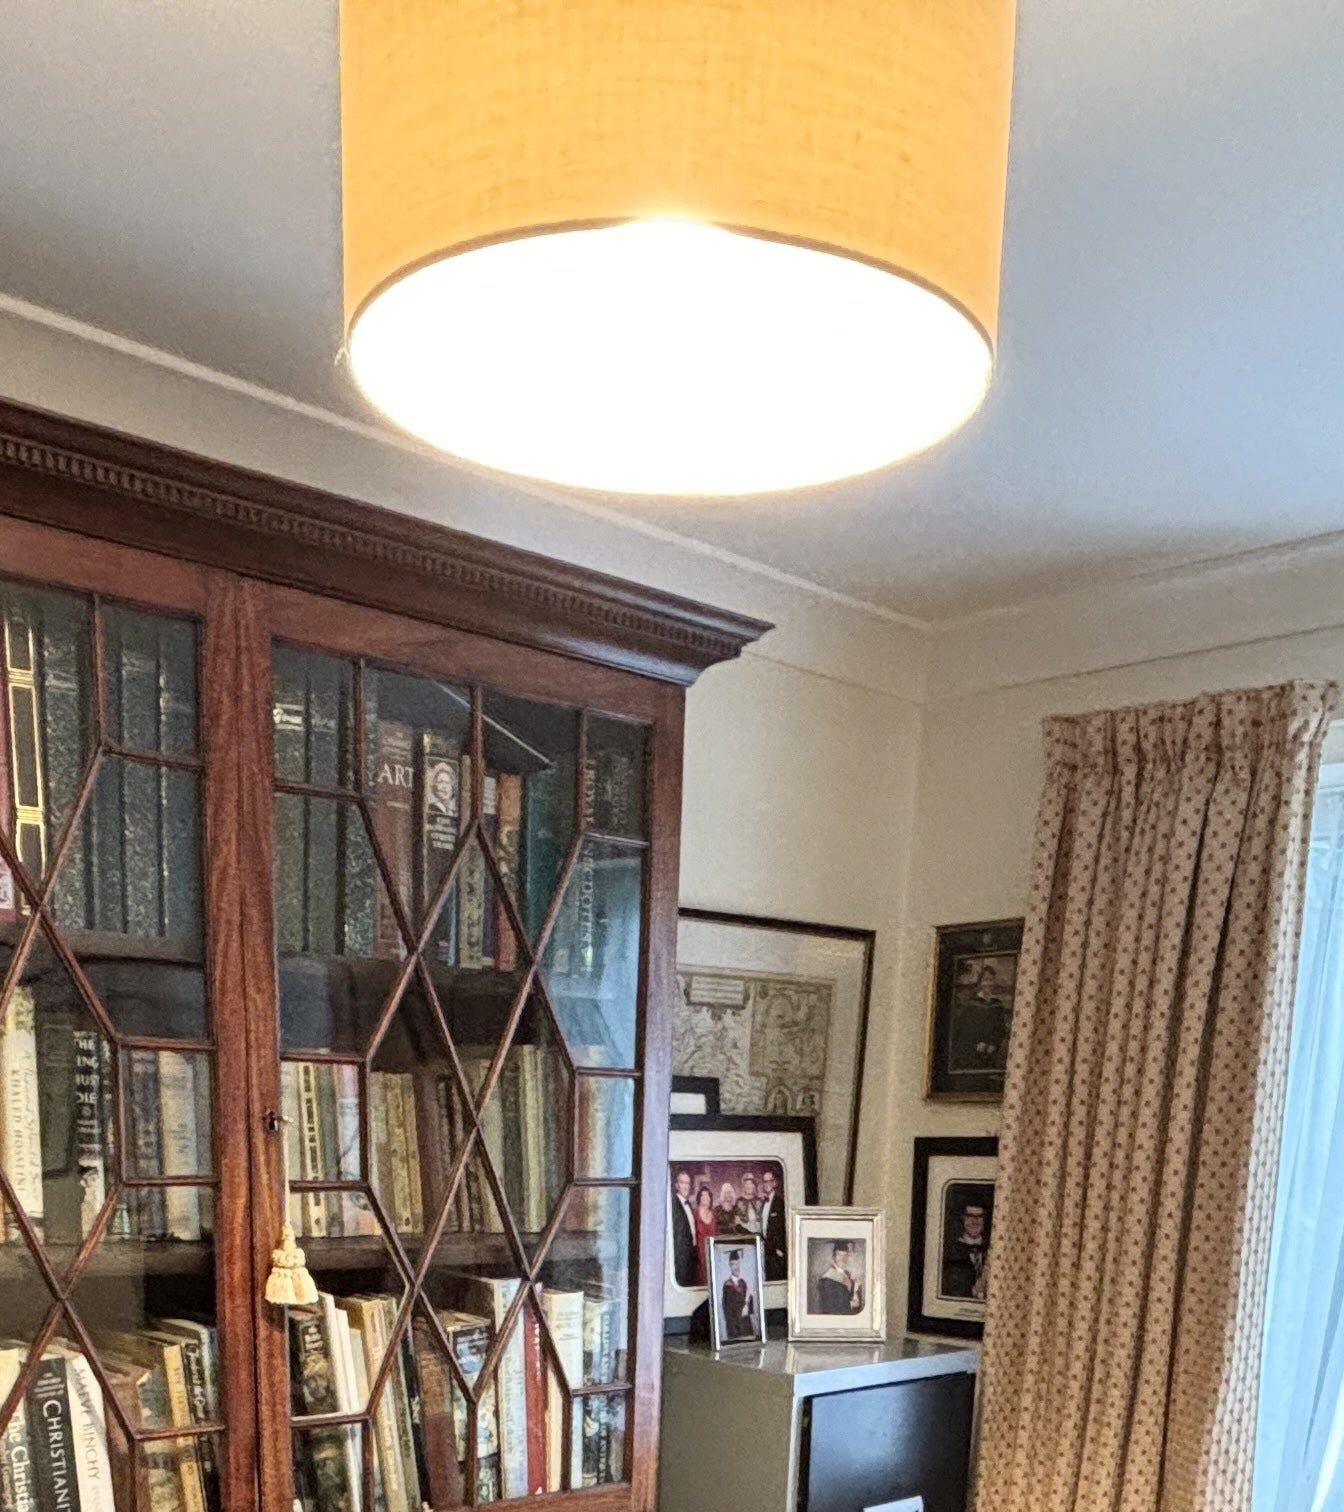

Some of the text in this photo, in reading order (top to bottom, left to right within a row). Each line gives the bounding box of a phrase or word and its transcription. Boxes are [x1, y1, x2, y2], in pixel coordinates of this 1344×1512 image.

[377, 762, 414, 788] ART
[74, 1368, 91, 1415] MAEVE
[82, 1422, 101, 1480] BINCHY
